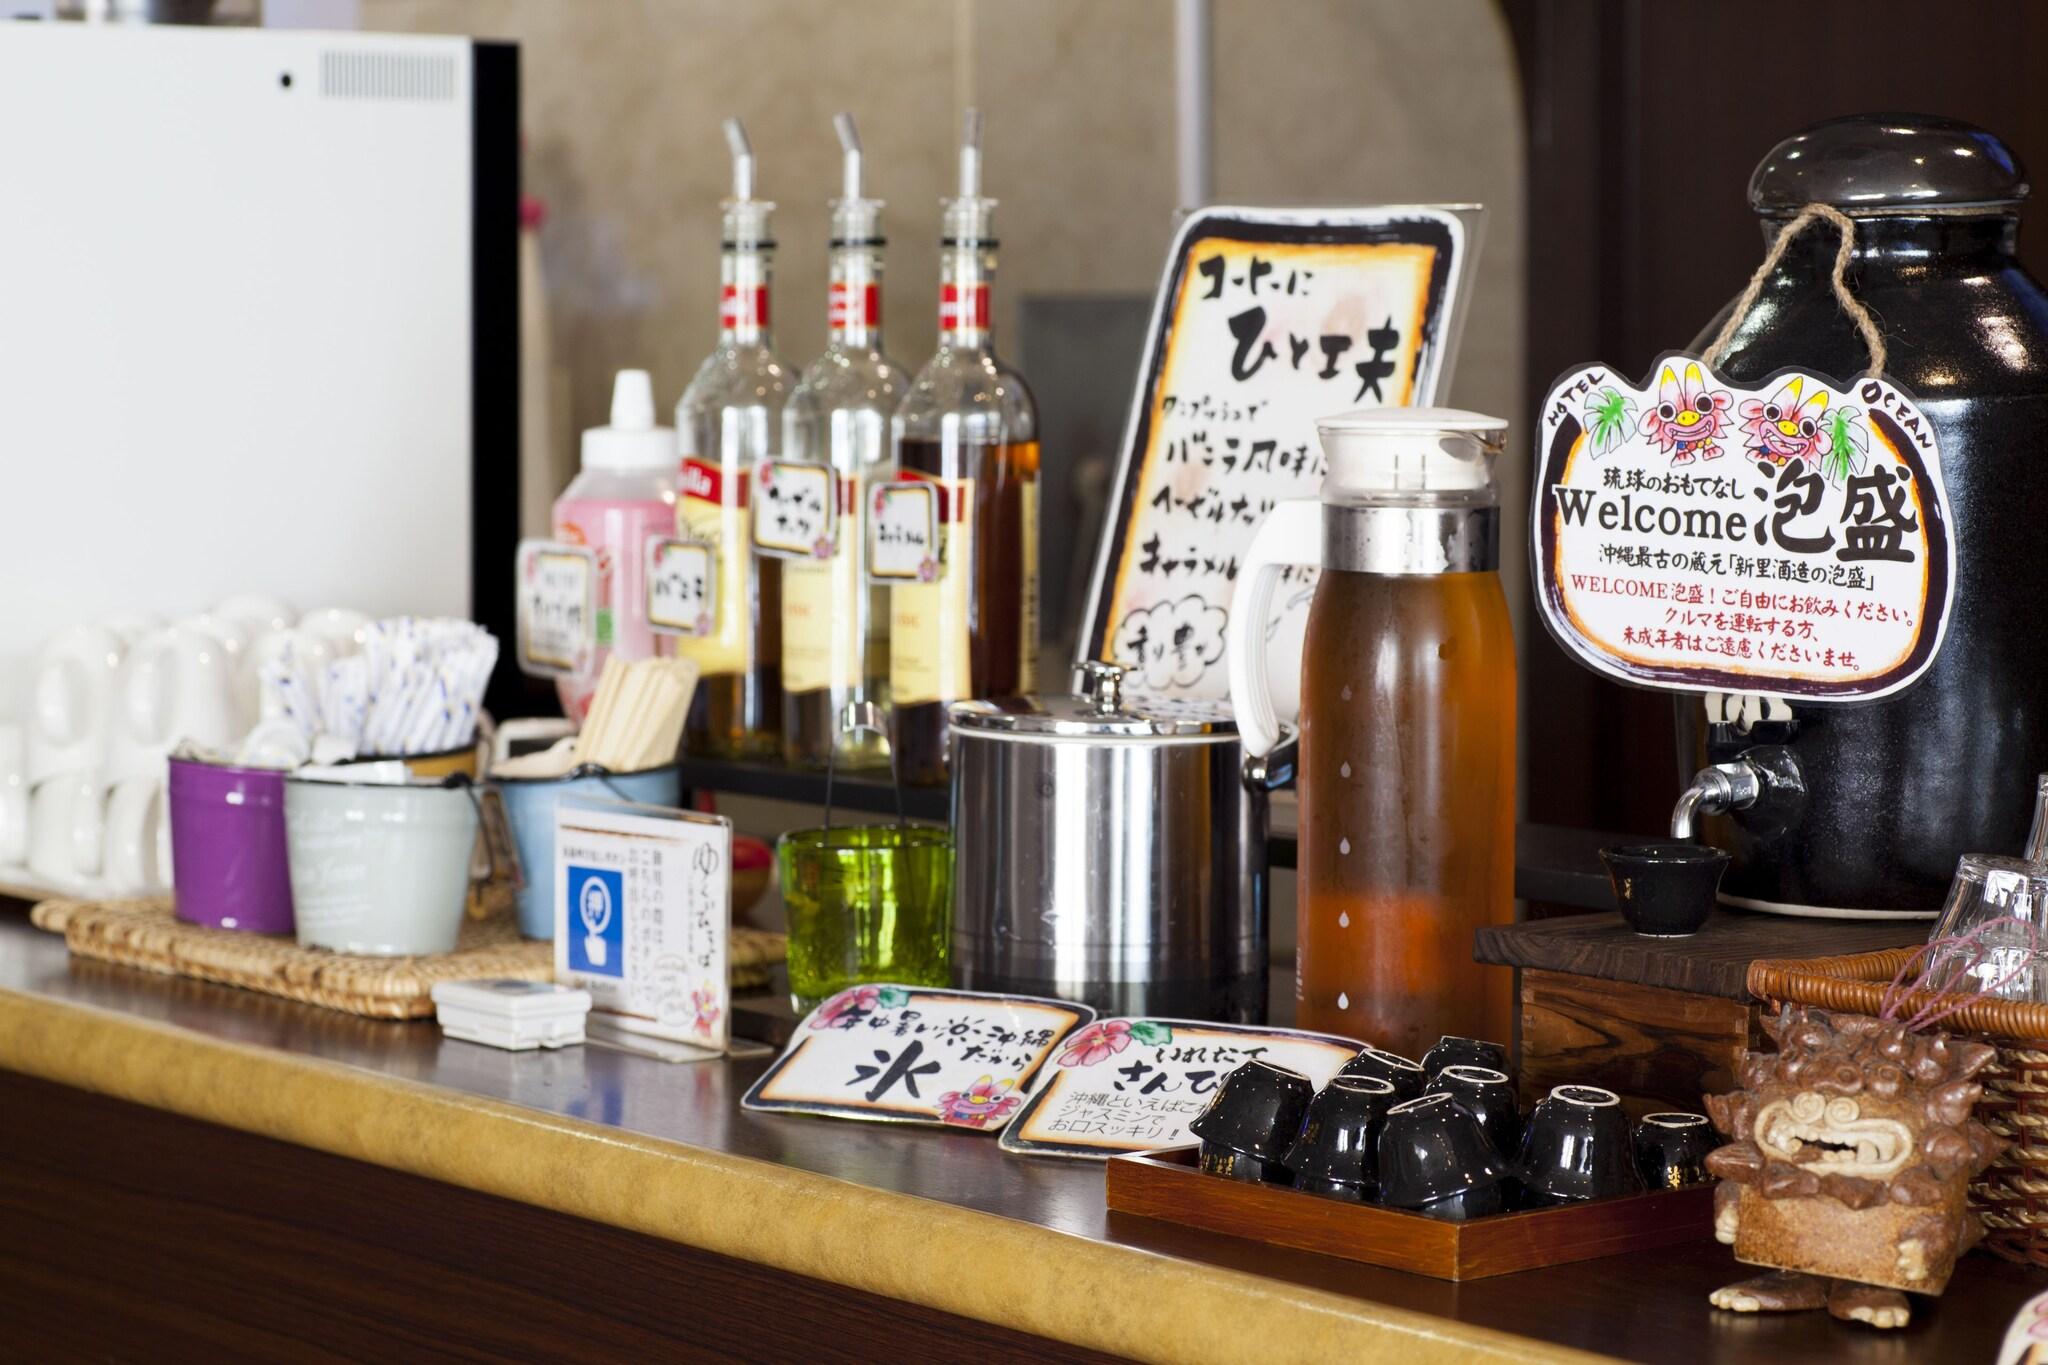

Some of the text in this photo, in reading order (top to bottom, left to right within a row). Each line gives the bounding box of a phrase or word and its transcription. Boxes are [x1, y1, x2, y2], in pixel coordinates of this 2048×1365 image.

[1548, 373, 1605, 426] HOTEL
[1862, 381, 1933, 448] OCEAN
[1603, 467, 1746, 501] 琉球のおもてなし
[1555, 458, 1920, 563] Welcome 泡盛
[1598, 543, 1875, 592] 沖縄最古の蔵元「新里酒造の泡盛」
[1664, 607, 1819, 642] クルマを運転する方、
[1623, 627, 1861, 671] 未成年者はご遠慮くださいませ。
[845, 1039, 942, 1103] 氷
[1155, 1045, 1269, 1065] いれたて
[1058, 1105, 1166, 1126] ジャスミンで
